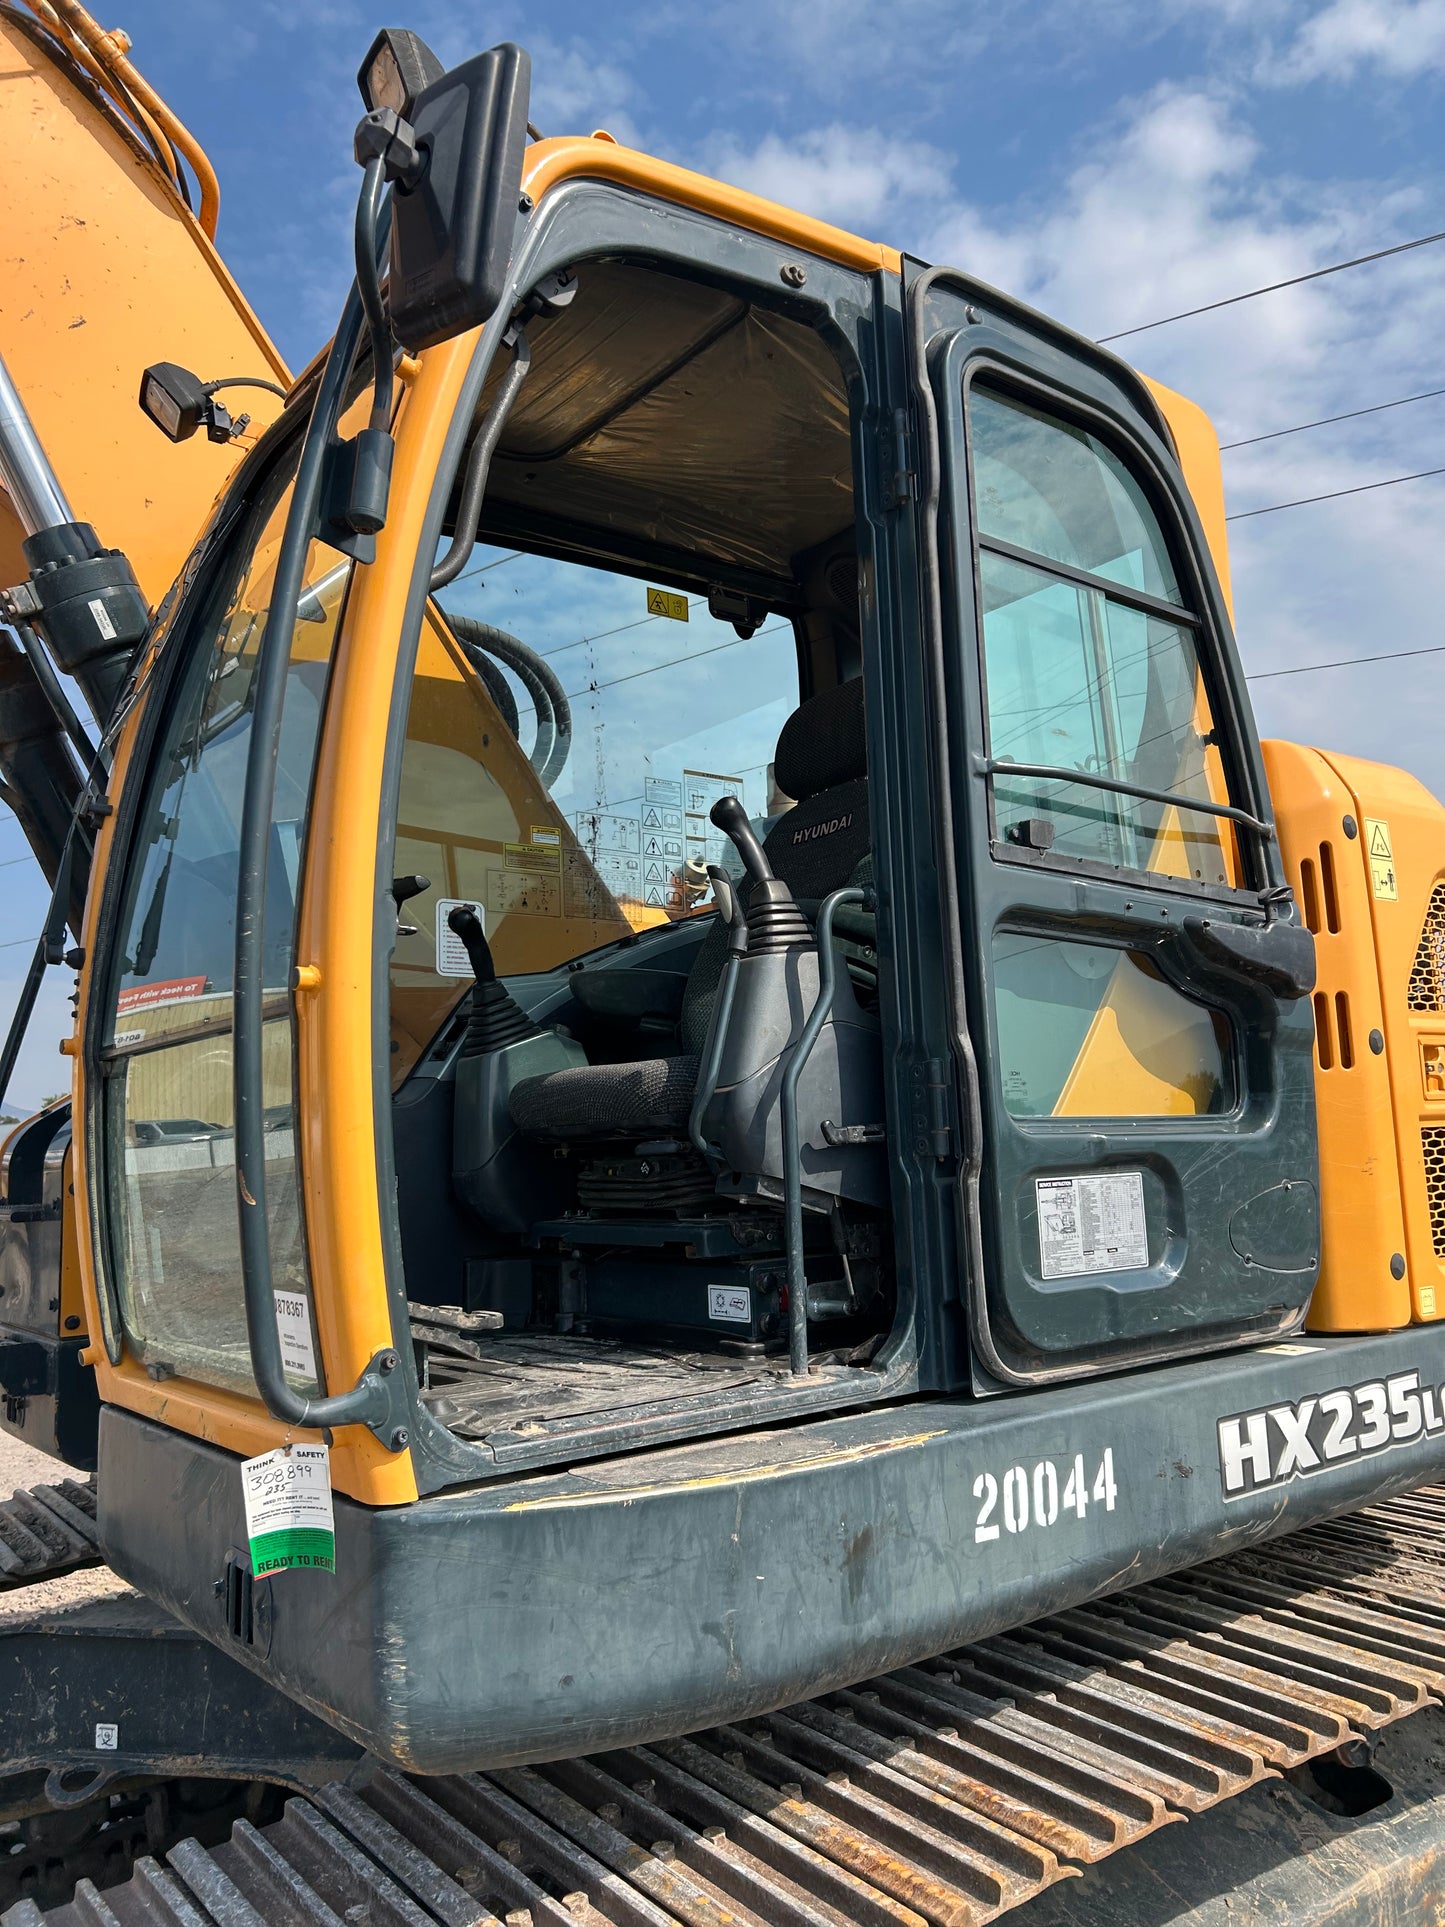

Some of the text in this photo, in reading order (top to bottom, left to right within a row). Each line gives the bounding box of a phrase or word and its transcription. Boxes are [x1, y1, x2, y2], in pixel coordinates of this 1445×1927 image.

[793, 813, 852, 845] HYUNDAI
[1222, 1371, 1445, 1493] HX235L
[247, 1451, 325, 1472] THINK SAFETY
[251, 1465, 312, 1491] 308899
[265, 1482, 292, 1497] 235
[972, 1447, 1118, 1544] 20044
[257, 1555, 294, 1573] READY
[297, 1555, 310, 1565] TO
